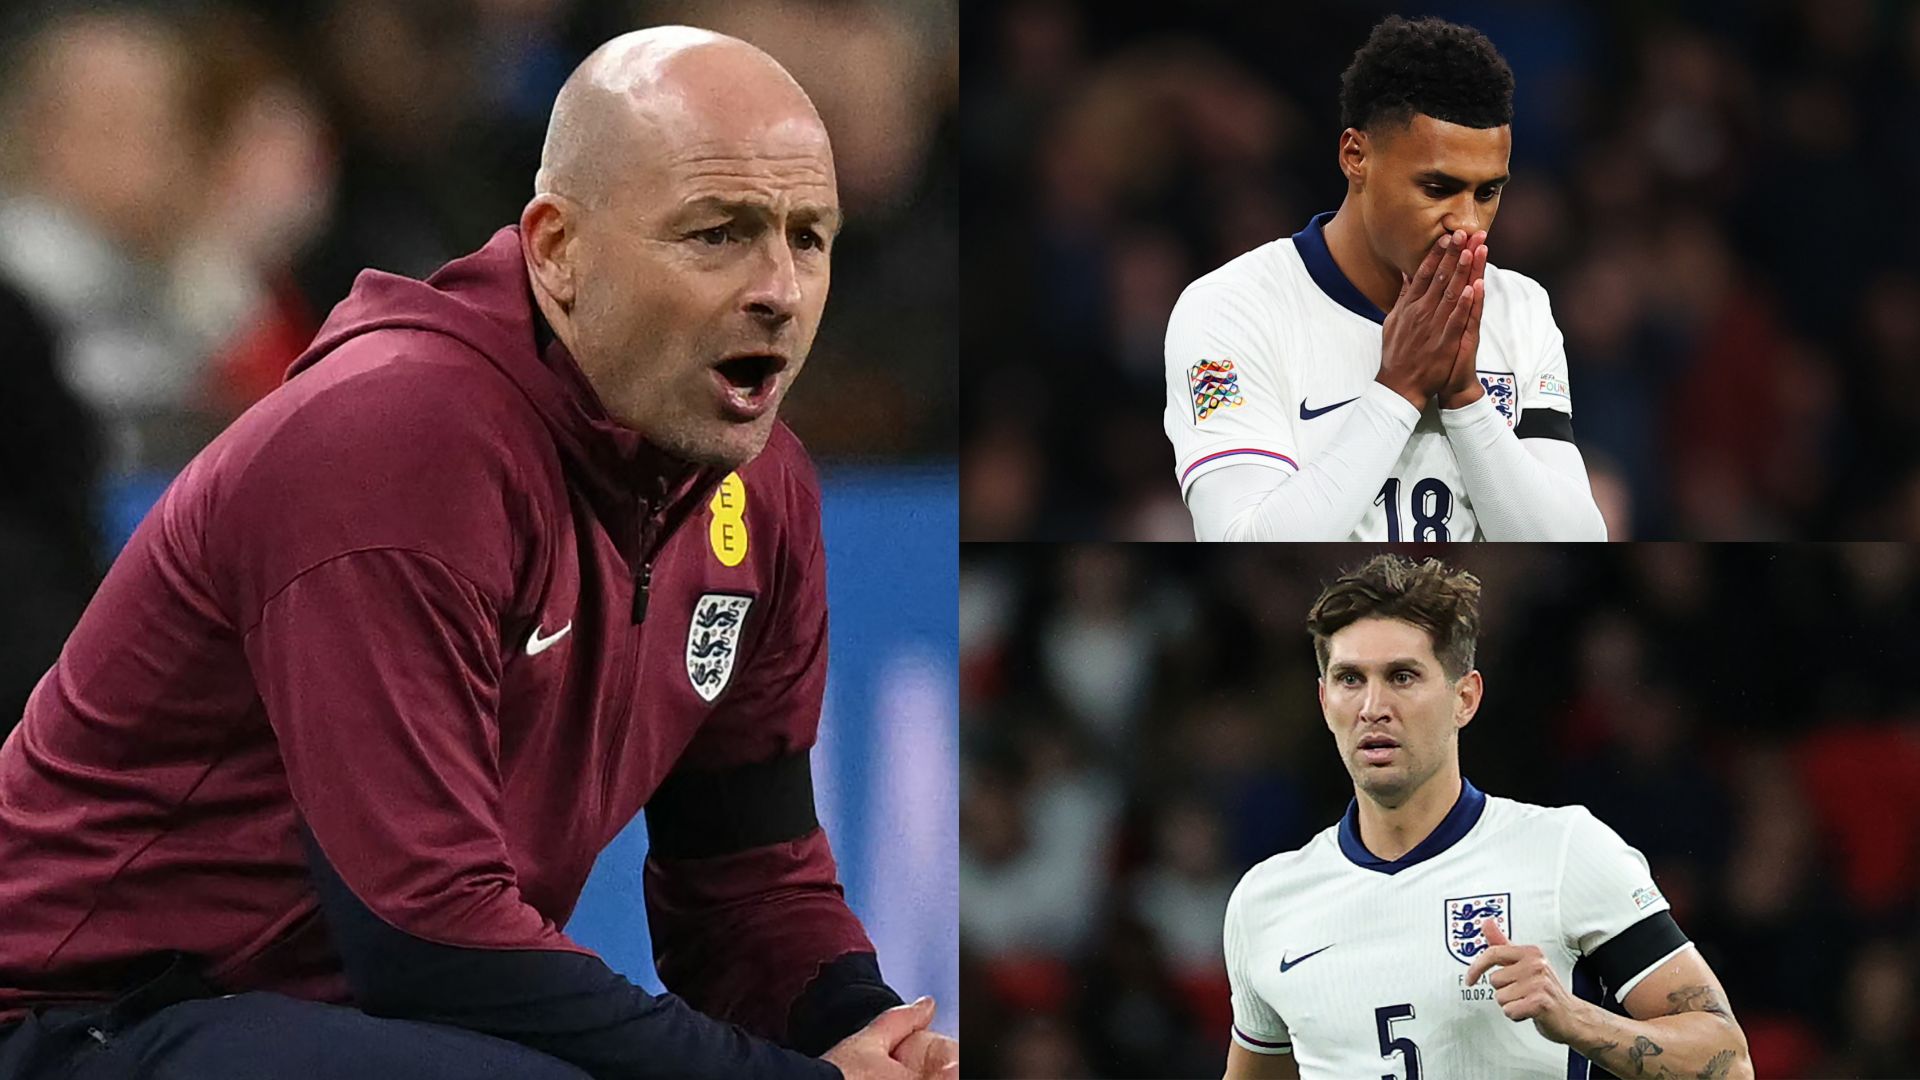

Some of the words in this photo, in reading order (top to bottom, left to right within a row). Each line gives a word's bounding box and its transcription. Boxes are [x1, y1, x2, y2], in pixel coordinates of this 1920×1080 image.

[1539, 380, 1569, 394] FOUN
[1373, 477, 1453, 542] 18
[1460, 988, 1494, 1001] 10.09.2
[1375, 1003, 1423, 1080] 5
